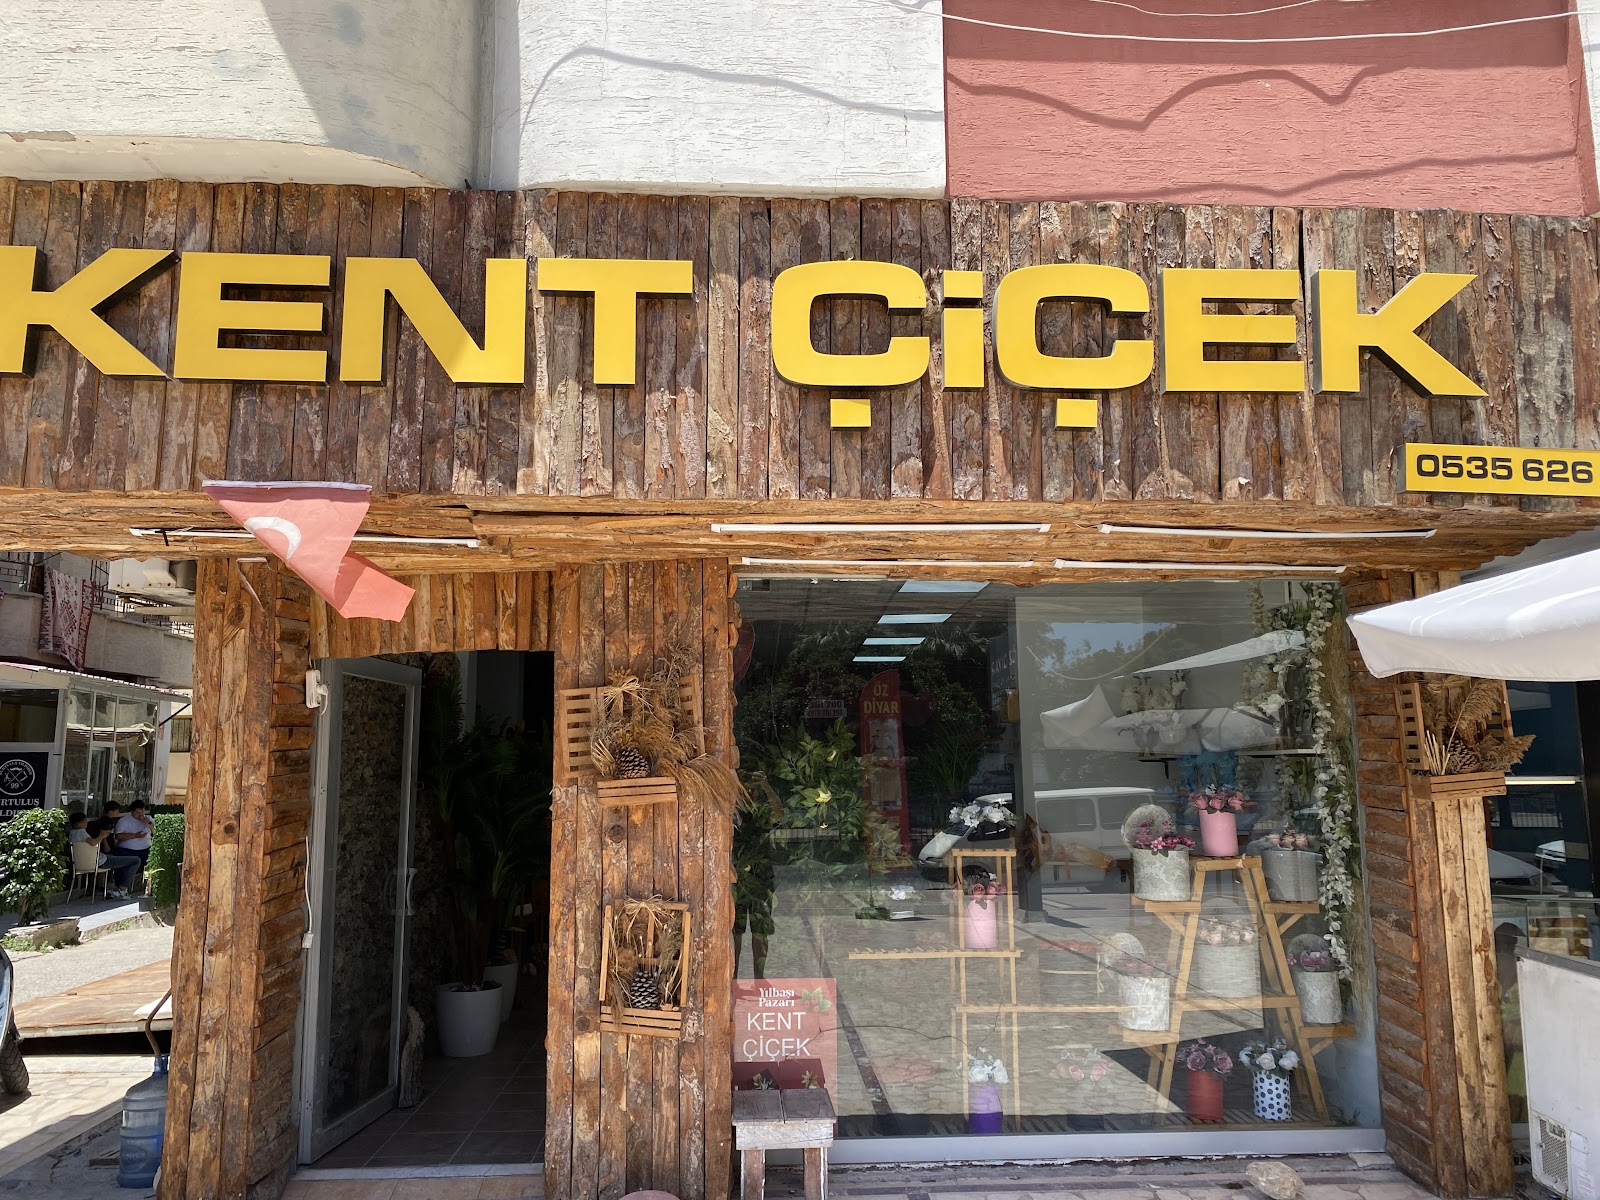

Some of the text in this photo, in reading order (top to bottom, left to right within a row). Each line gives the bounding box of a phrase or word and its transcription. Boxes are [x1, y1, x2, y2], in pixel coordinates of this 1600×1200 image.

[0, 245, 694, 385] KENT
[1416, 454, 1593, 484] 0535 626
[873, 681, 889, 697] ÖZ
[863, 697, 899, 714] DİYAR
[0, 798, 40, 807] RTULUŞ
[758, 987, 795, 998] Yılbaşı
[758, 998, 795, 1007] Pazarı
[746, 1011, 807, 1031] KENT
[742, 1035, 811, 1062] ÇİÇEK
